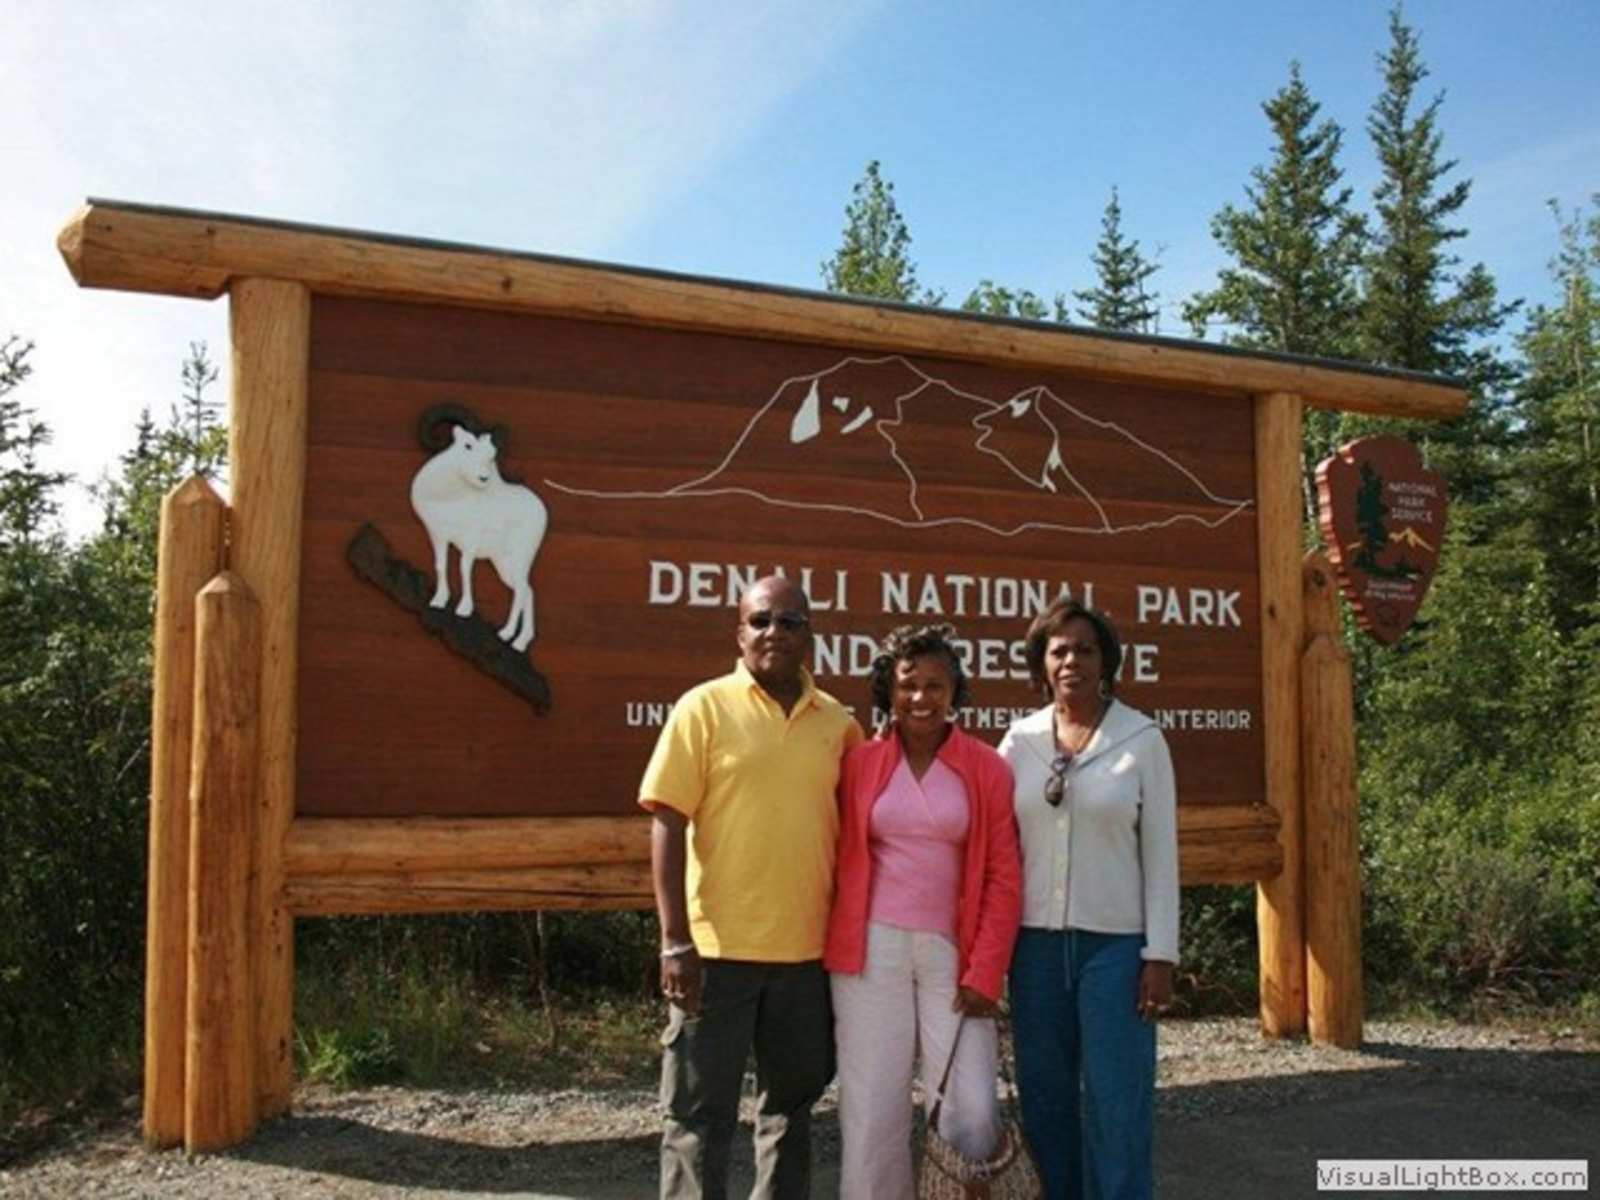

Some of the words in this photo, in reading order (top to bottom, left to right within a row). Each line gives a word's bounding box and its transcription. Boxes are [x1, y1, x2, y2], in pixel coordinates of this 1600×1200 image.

[649, 560, 848, 611] DENLI
[1137, 585, 1242, 628] PARK
[812, 633, 881, 677] ND
[1154, 708, 1252, 730] INTERIOR
